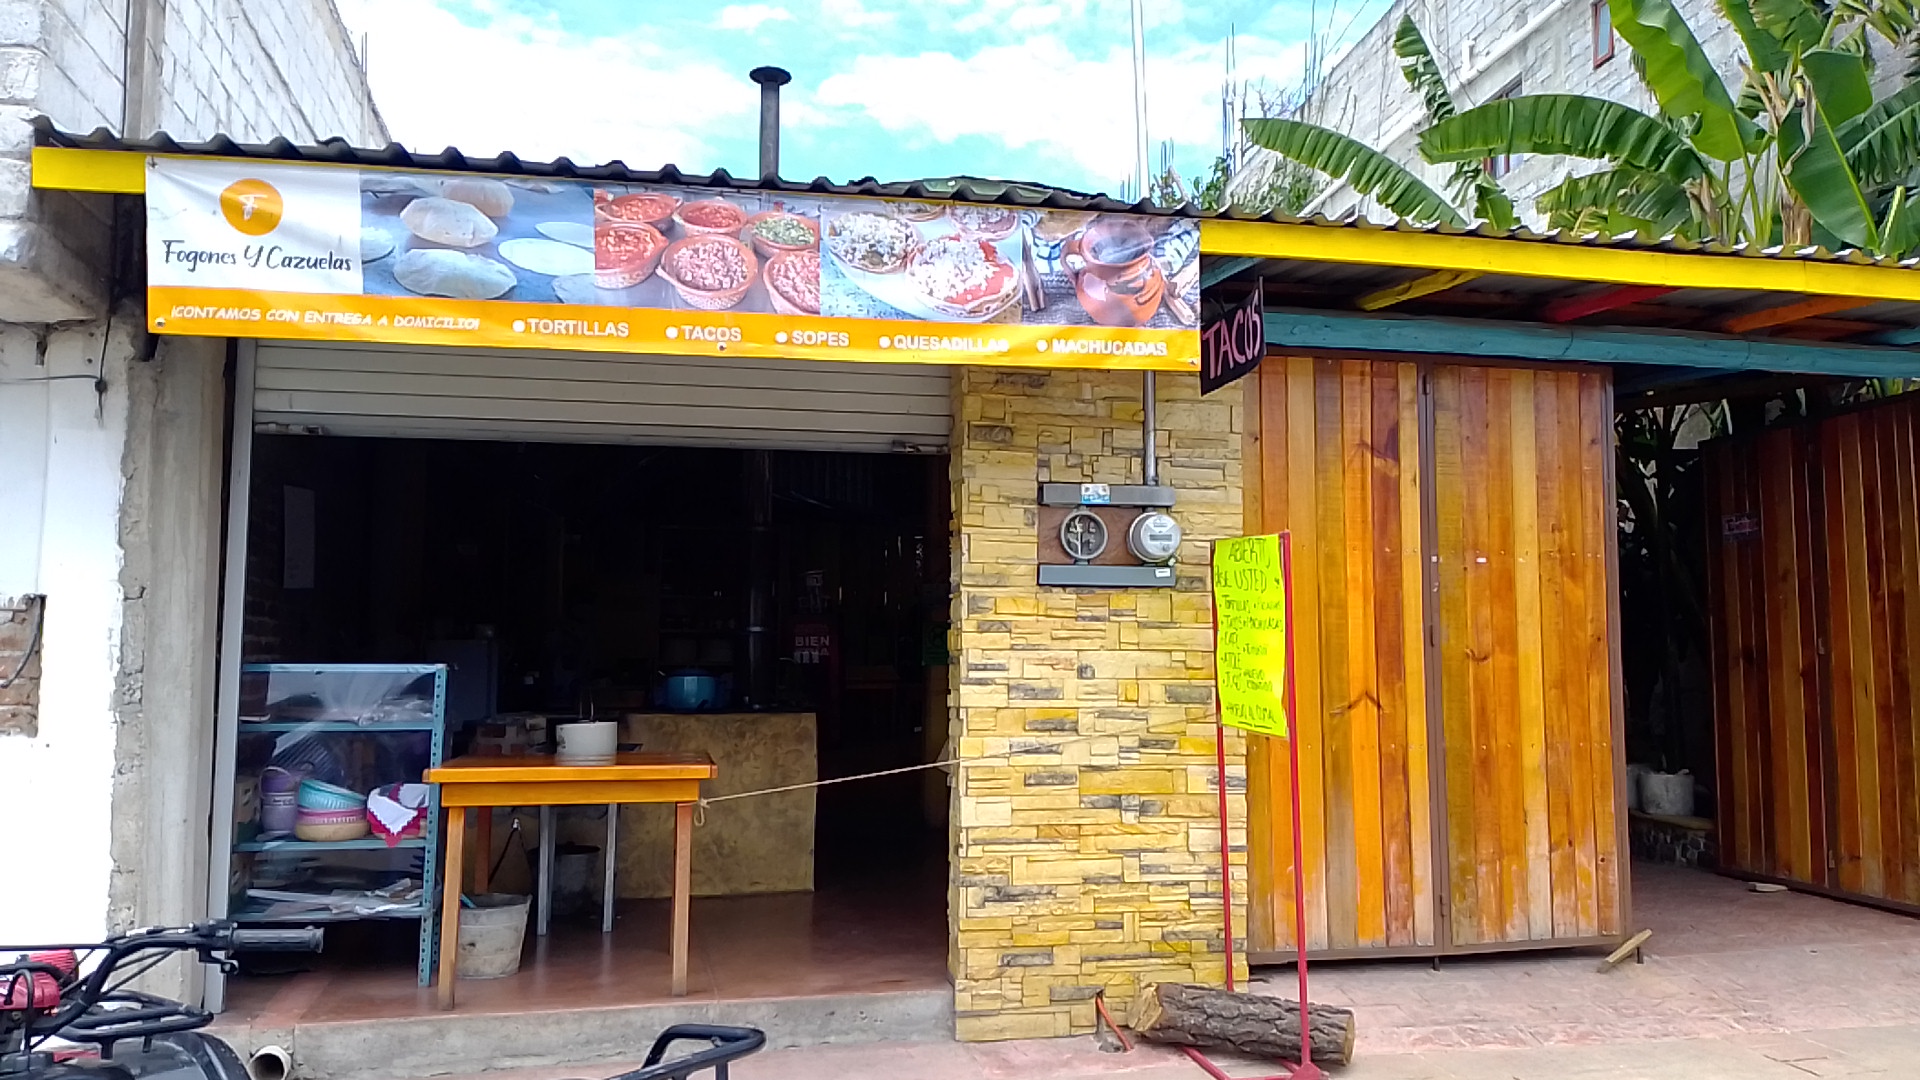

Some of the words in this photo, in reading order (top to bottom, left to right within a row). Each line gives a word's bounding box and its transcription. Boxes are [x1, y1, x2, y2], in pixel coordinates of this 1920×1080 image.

[162, 239, 236, 272] Fogones
[244, 245, 264, 267] Y
[266, 245, 352, 271] Cazuelas
[266, 309, 300, 322] CON
[304, 311, 372, 325] ENTREGA
[377, 315, 388, 326] A
[527, 318, 629, 338] TORTILLAS
[680, 325, 742, 342] TACOS
[1202, 288, 1261, 380] TACOS
[792, 330, 850, 347] SOPES
[893, 334, 1009, 352] QUESADILLAS
[1052, 338, 1168, 357] MACHUCADAS
[1234, 569, 1268, 593] USTED
